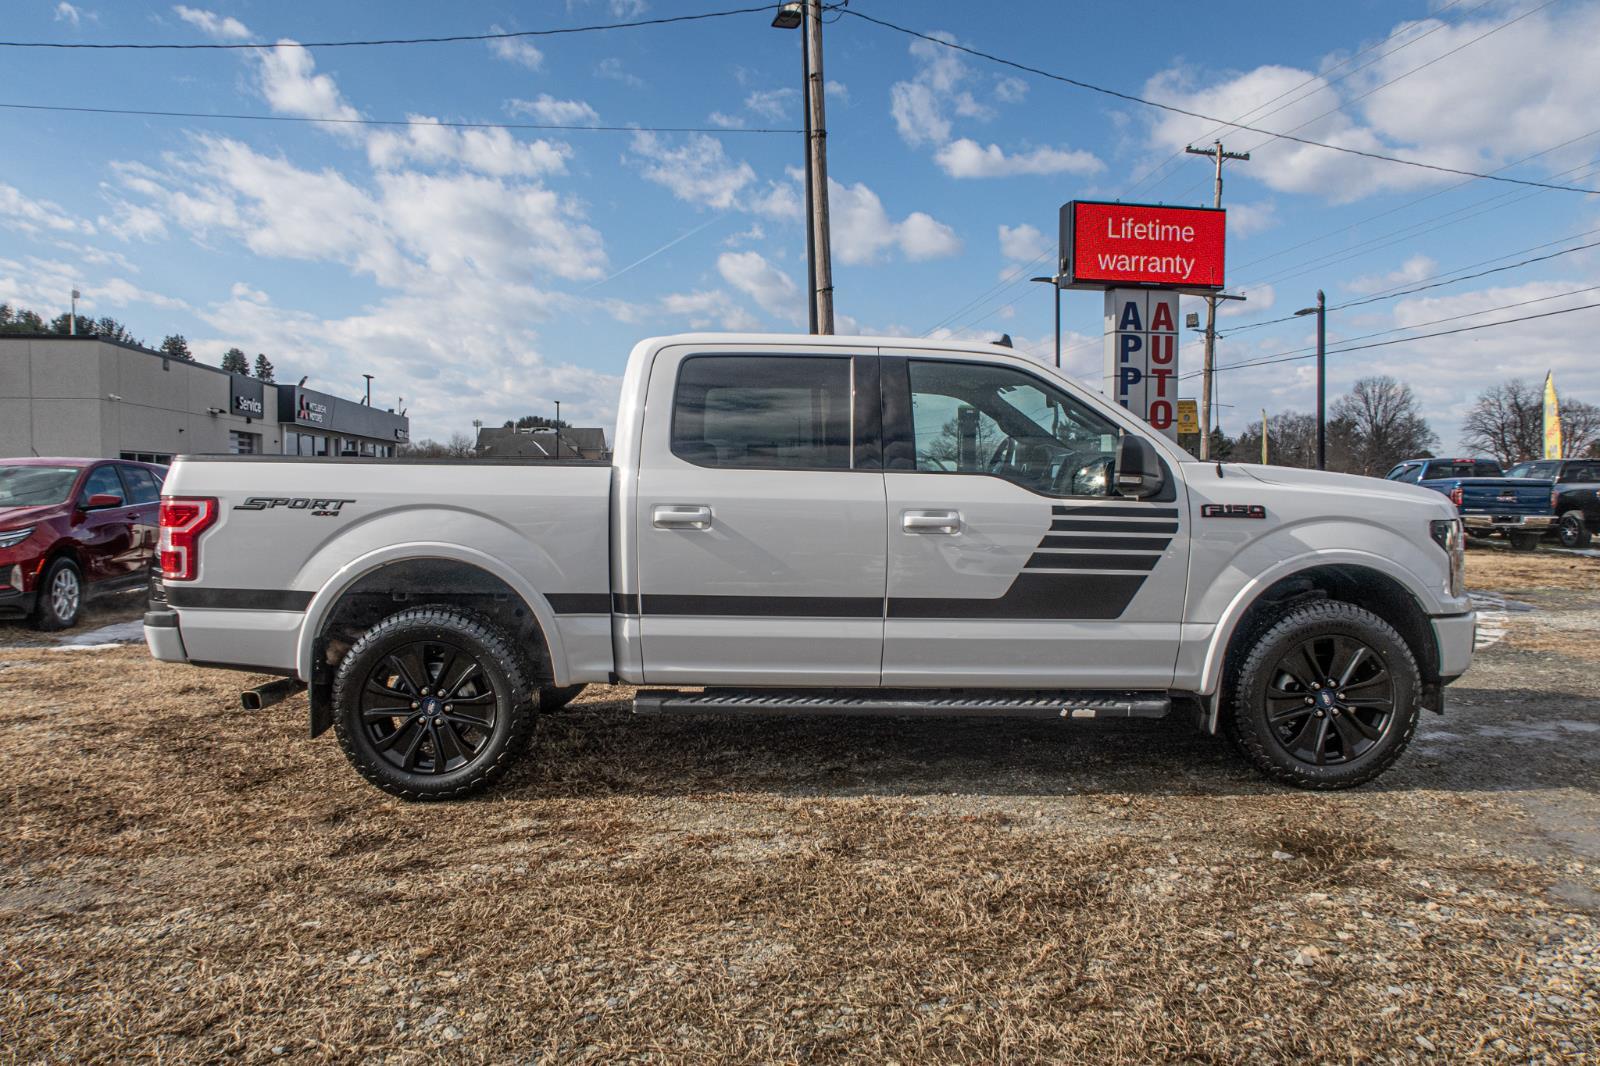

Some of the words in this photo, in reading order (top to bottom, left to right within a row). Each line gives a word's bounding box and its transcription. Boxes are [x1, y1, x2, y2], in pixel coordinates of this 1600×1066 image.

[1107, 217, 1196, 243] Lifetime
[1098, 253, 1196, 281] warranty
[1119, 301, 1143, 410] APP
[1150, 302, 1175, 430] AUTO
[239, 396, 262, 413] Service
[233, 496, 357, 511] SPORT
